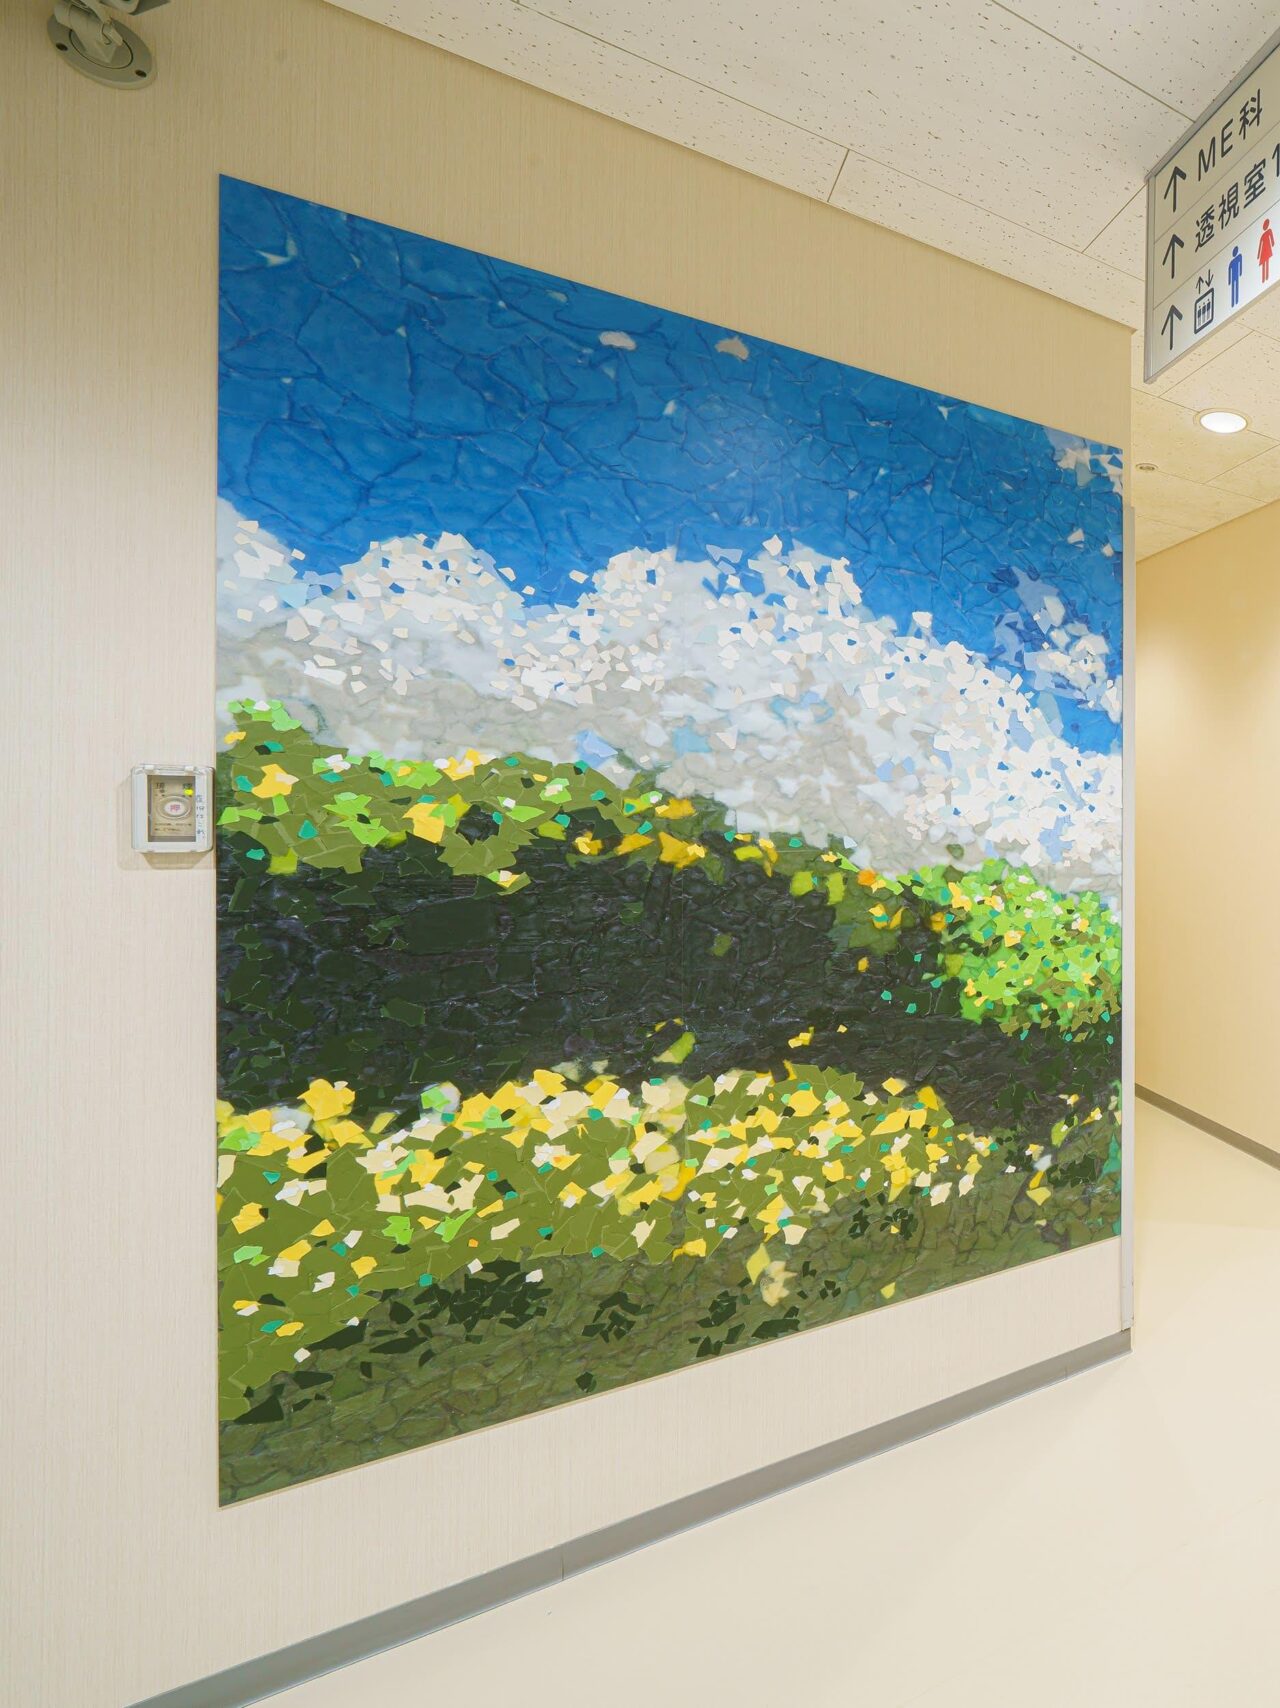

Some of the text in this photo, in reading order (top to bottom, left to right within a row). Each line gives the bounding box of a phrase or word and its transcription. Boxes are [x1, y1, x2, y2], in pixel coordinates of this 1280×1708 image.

[1198, 88, 1262, 182] ME科
[1194, 143, 1280, 253] 透視室1
